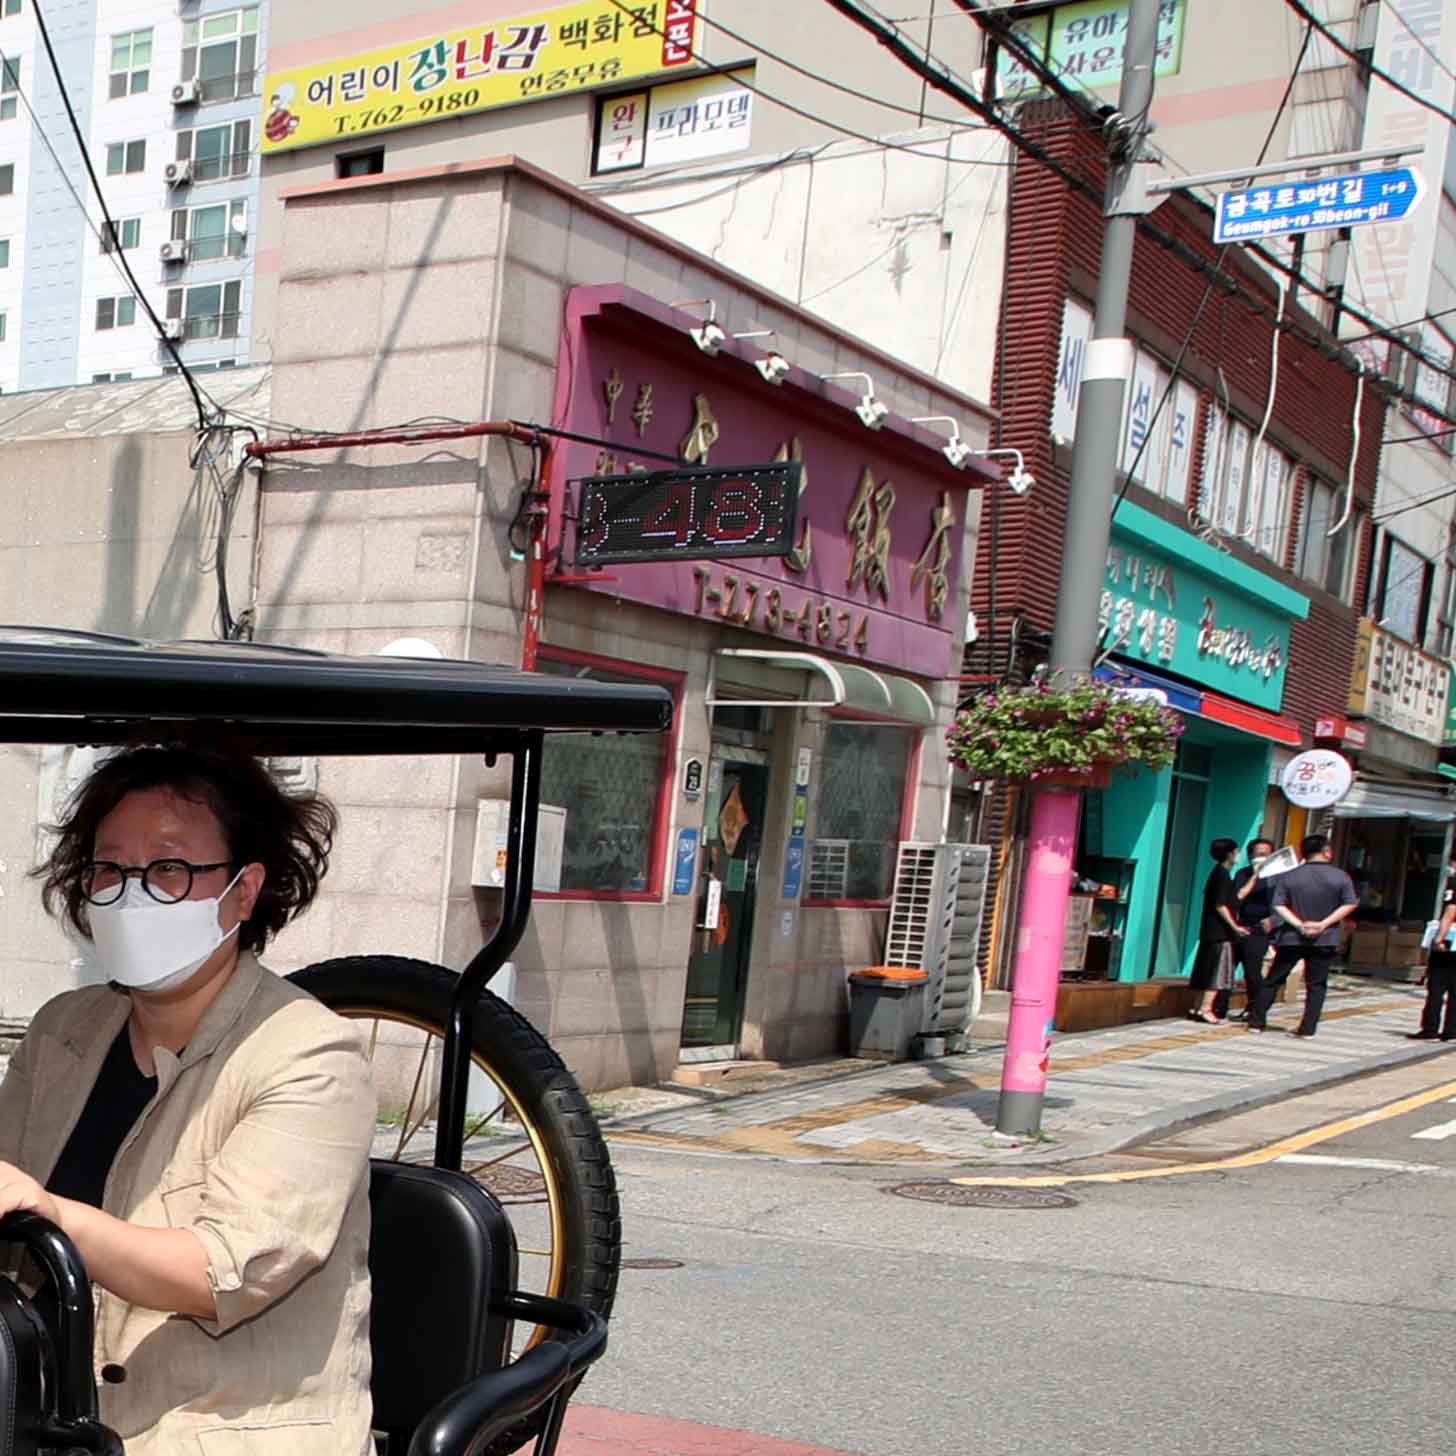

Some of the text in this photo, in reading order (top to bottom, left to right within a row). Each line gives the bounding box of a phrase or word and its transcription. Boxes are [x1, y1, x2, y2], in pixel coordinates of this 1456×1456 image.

[307, 3, 658, 105] 어린이 장난감 백화점
[334, 88, 480, 134] T.762-9180
[654, 92, 751, 141] 프라모델
